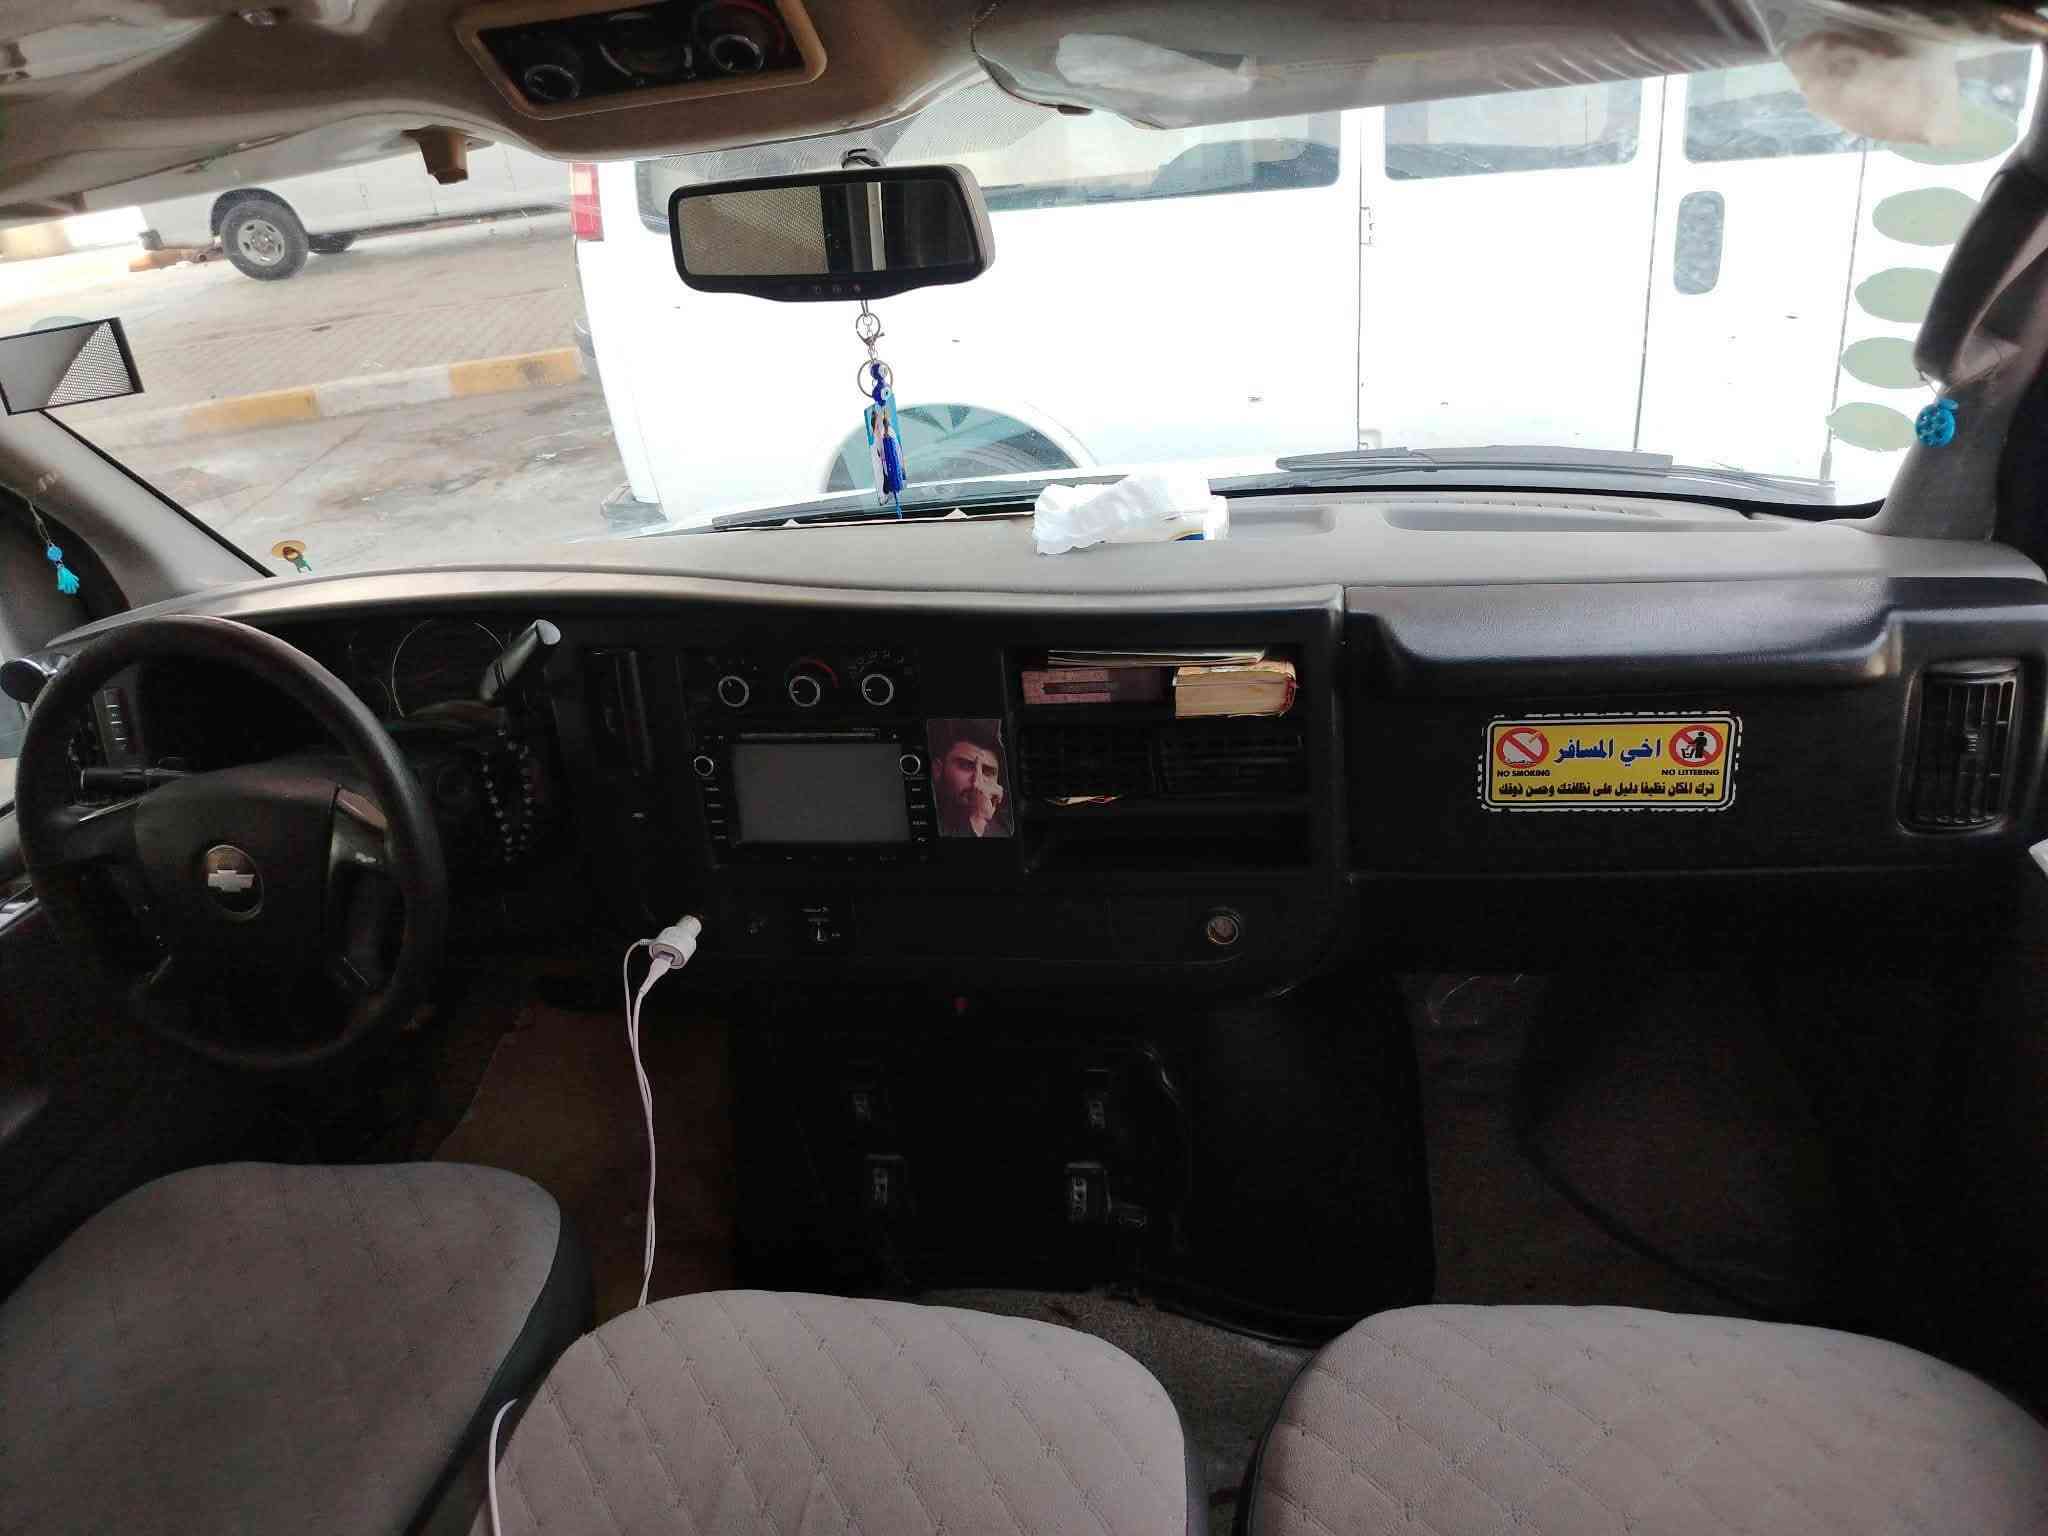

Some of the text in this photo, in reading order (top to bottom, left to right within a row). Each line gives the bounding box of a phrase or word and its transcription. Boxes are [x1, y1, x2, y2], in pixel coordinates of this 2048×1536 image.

[1553, 737, 1614, 764] المسافر
[1496, 769, 1551, 777] NO SMOKING
[1525, 783, 1555, 797] وحسن
[1556, 781, 1591, 796] نظافتك
[1614, 782, 1638, 796] دليل
[1667, 782, 1692, 797] المكان
[1694, 782, 1715, 797] ترك
